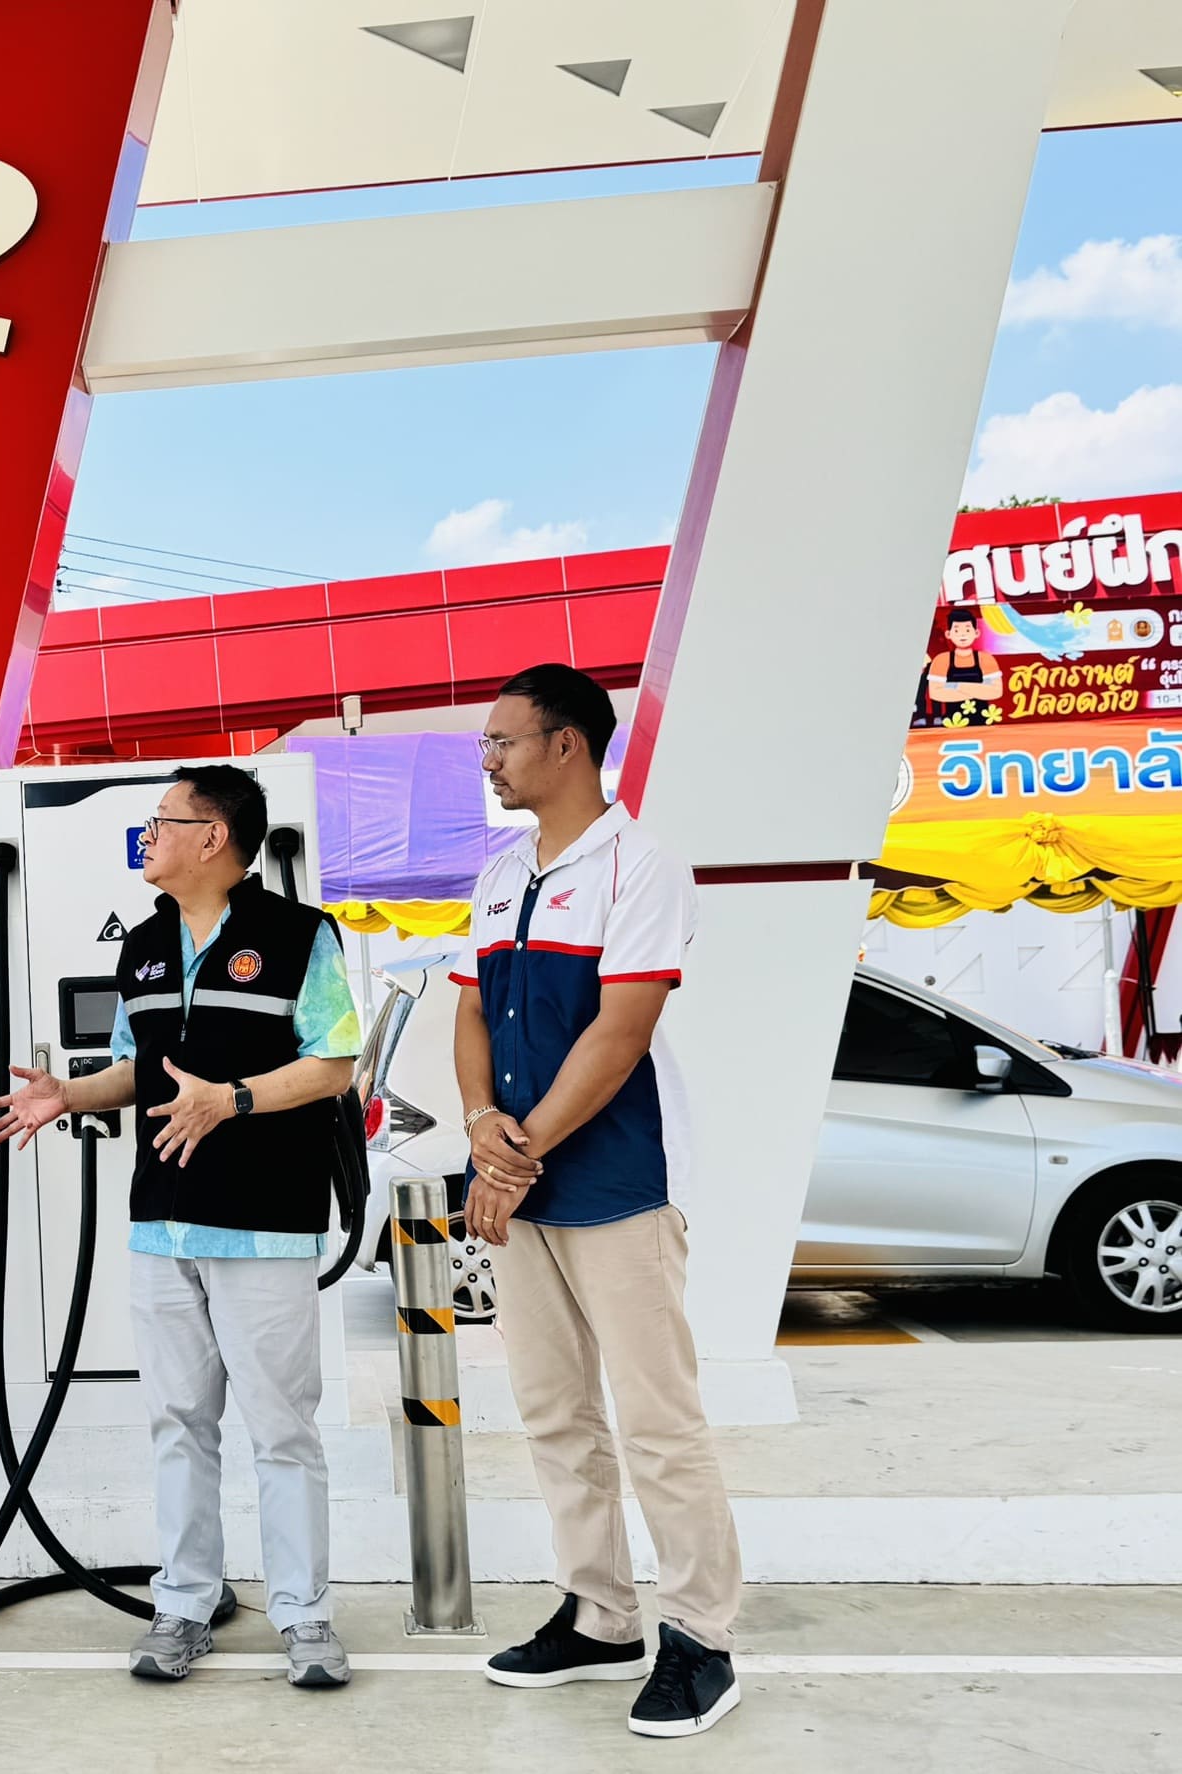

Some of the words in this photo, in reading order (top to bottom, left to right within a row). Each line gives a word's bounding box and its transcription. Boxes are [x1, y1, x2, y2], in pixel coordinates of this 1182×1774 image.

[1008, 655, 1141, 692] สงกรานต์
[1008, 685, 1140, 718] ปลอดภัย
[72, 1060, 79, 1069] A
